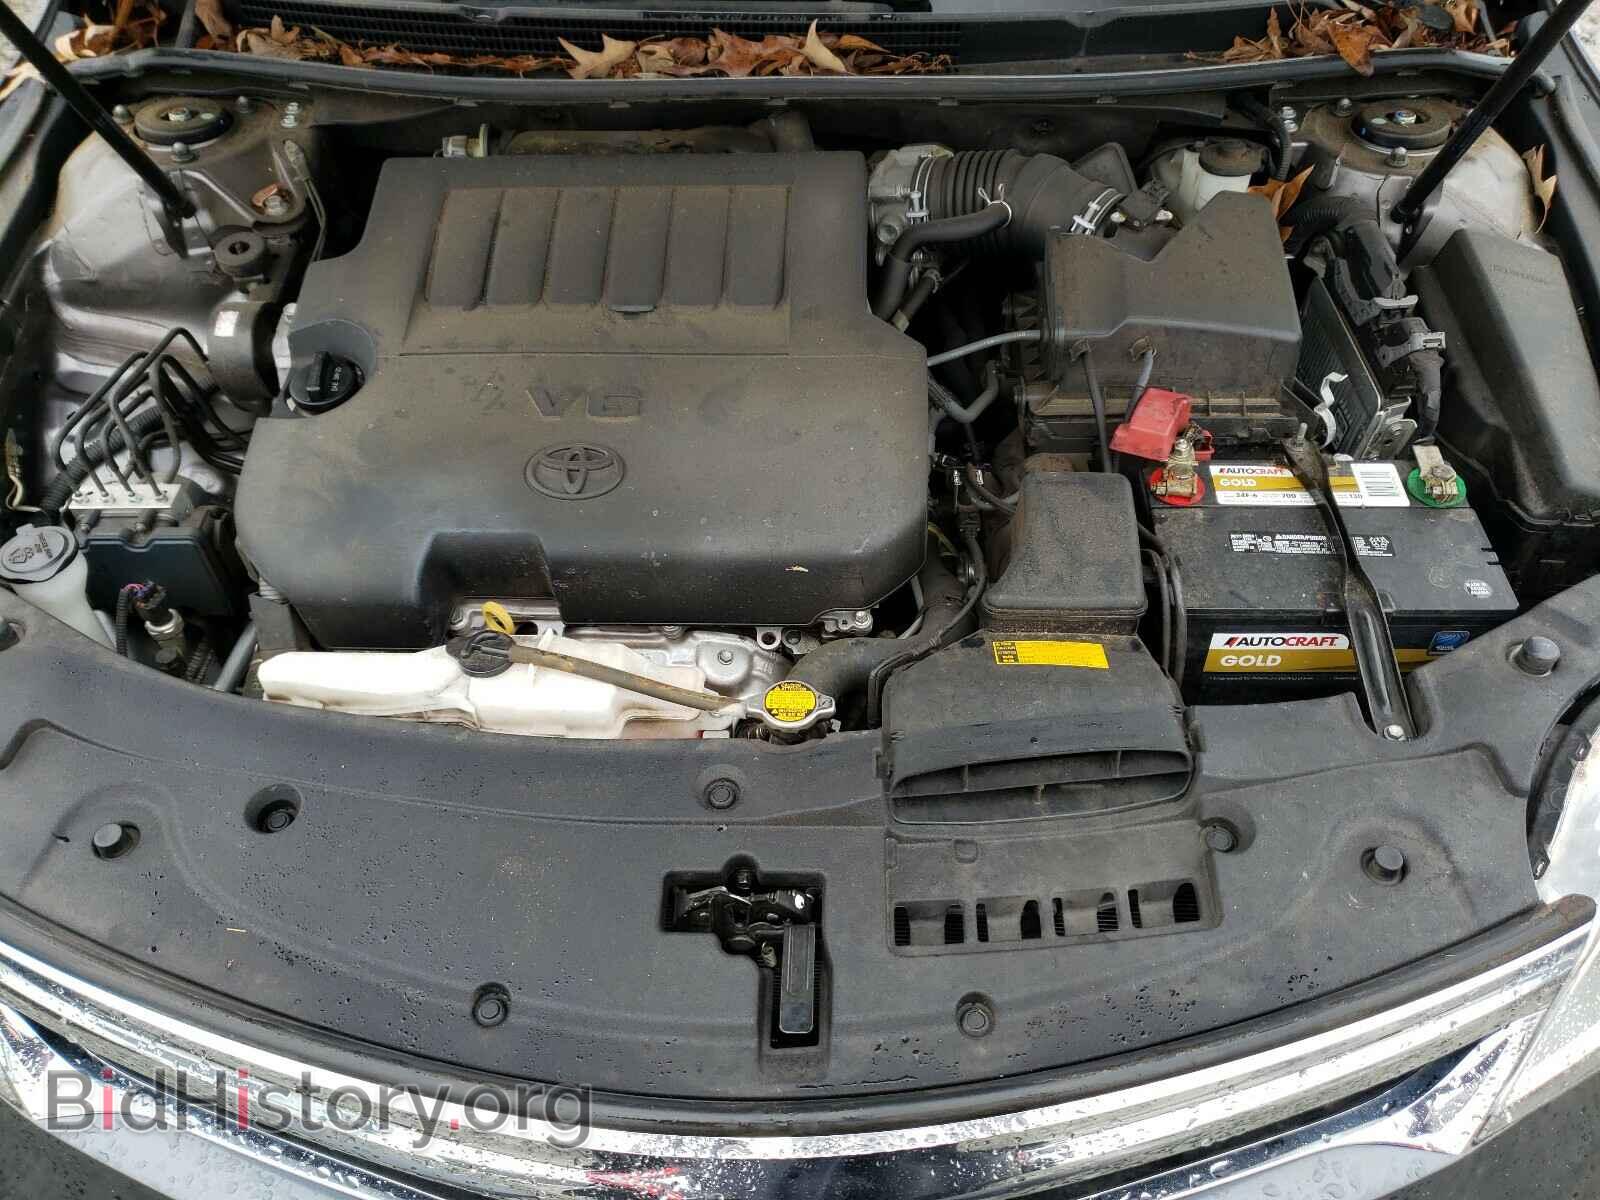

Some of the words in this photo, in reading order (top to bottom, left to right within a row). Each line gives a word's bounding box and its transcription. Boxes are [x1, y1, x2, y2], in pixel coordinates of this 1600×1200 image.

[526, 387, 641, 422] V6
[1226, 467, 1284, 475] AUTOCRAFT
[1220, 478, 1257, 487] GOLD
[1236, 636, 1339, 647] AUTOCRAFT
[1220, 655, 1282, 667] GOLD
